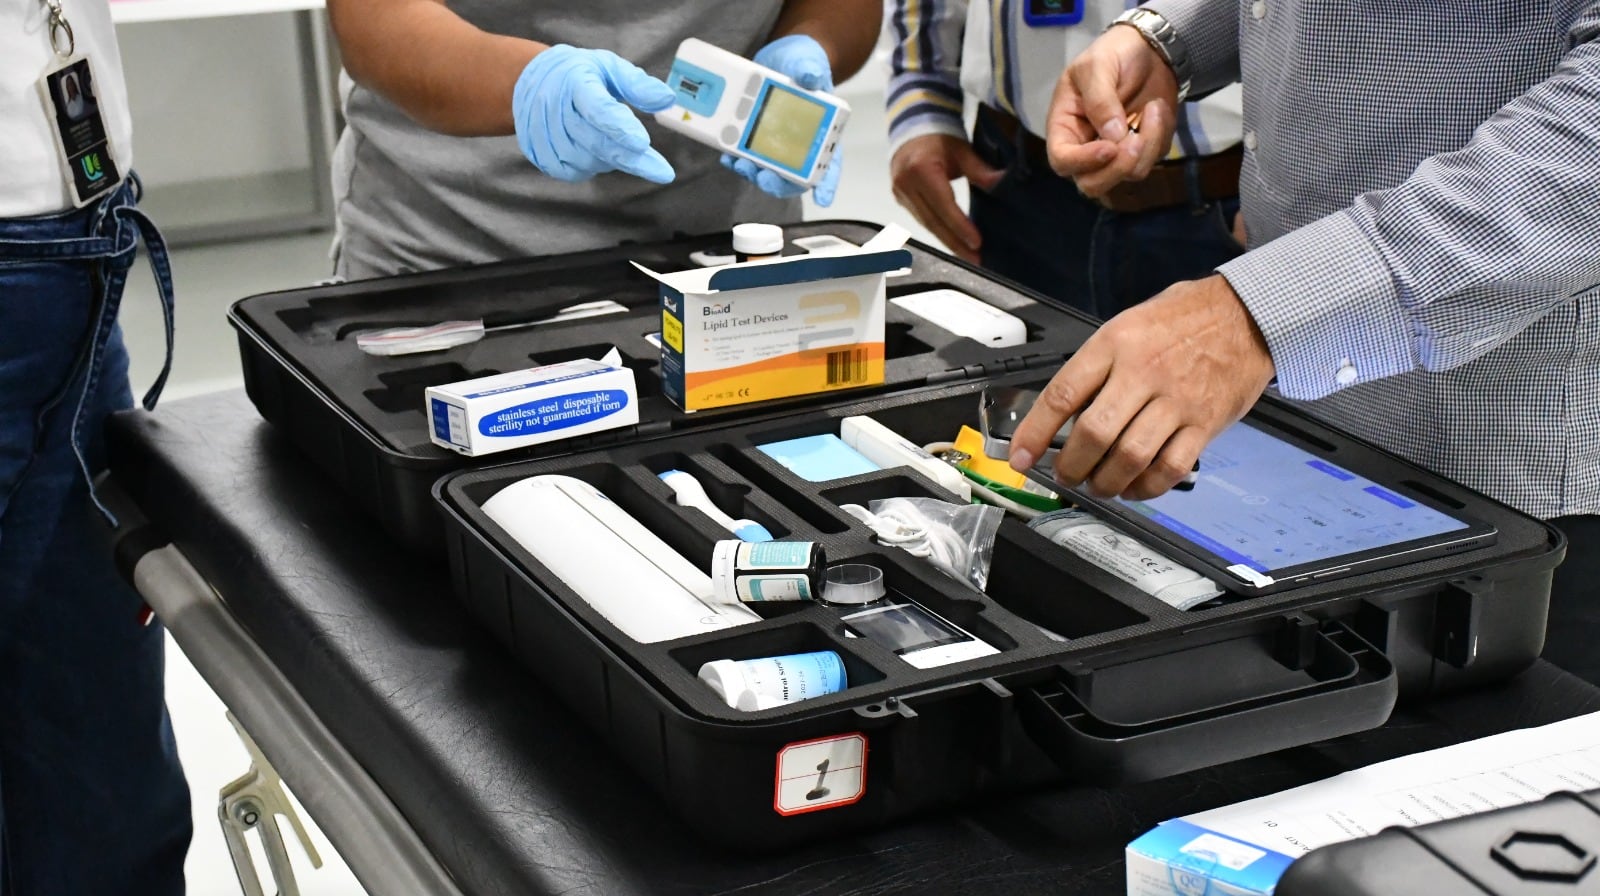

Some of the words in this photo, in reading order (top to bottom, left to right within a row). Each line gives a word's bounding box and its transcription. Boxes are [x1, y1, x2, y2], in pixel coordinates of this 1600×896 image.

[703, 319, 728, 332] Lipid
[731, 317, 750, 327] Test
[753, 313, 789, 325] Devices
[488, 418, 524, 434] sterility
[525, 416, 541, 427] not
[542, 405, 591, 426] guaranteed
[593, 402, 601, 413] if
[602, 401, 621, 411] torn
[497, 408, 536, 423] stainless
[537, 401, 559, 415] steel
[563, 392, 610, 409] disposable
[805, 758, 831, 801] 1
